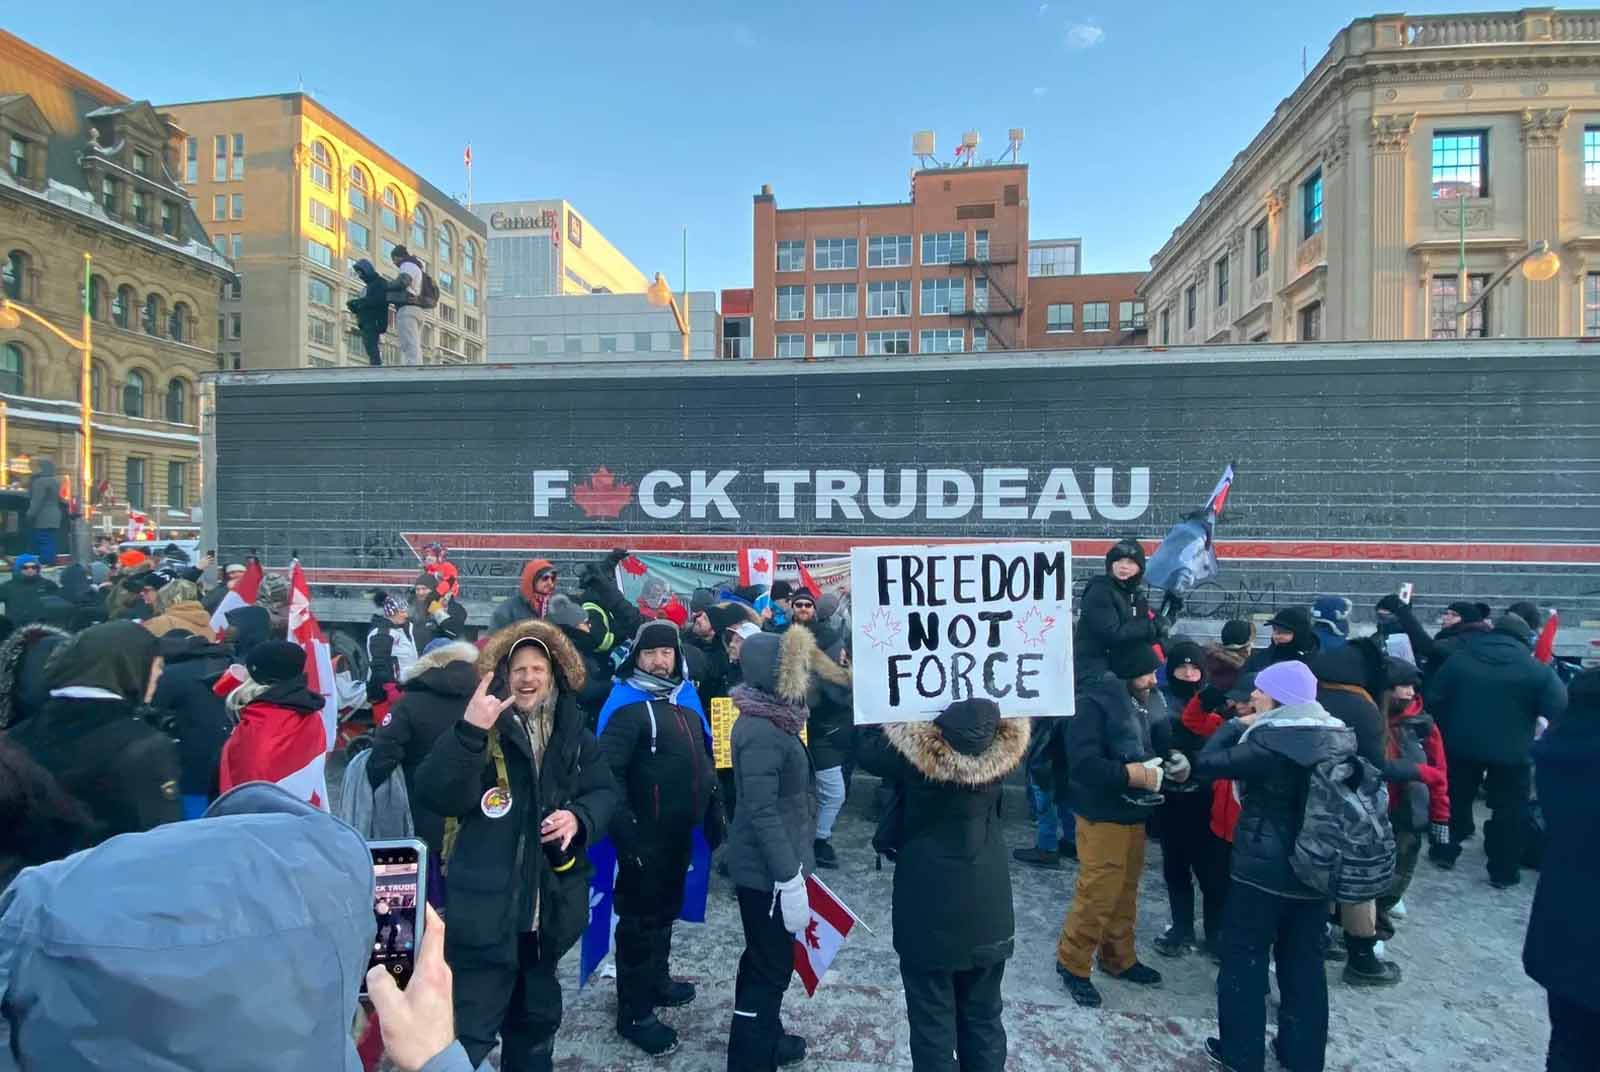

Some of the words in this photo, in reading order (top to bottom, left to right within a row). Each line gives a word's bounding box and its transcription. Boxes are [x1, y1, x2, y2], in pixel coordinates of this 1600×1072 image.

[490, 208, 557, 231] Canada
[533, 465, 740, 518] FCK
[763, 467, 1150, 520] TRUDEAU
[713, 563, 737, 572] NOUS
[877, 551, 1065, 607] FREEDOM
[908, 610, 1013, 651] NOT
[888, 652, 1044, 707] FORCE
